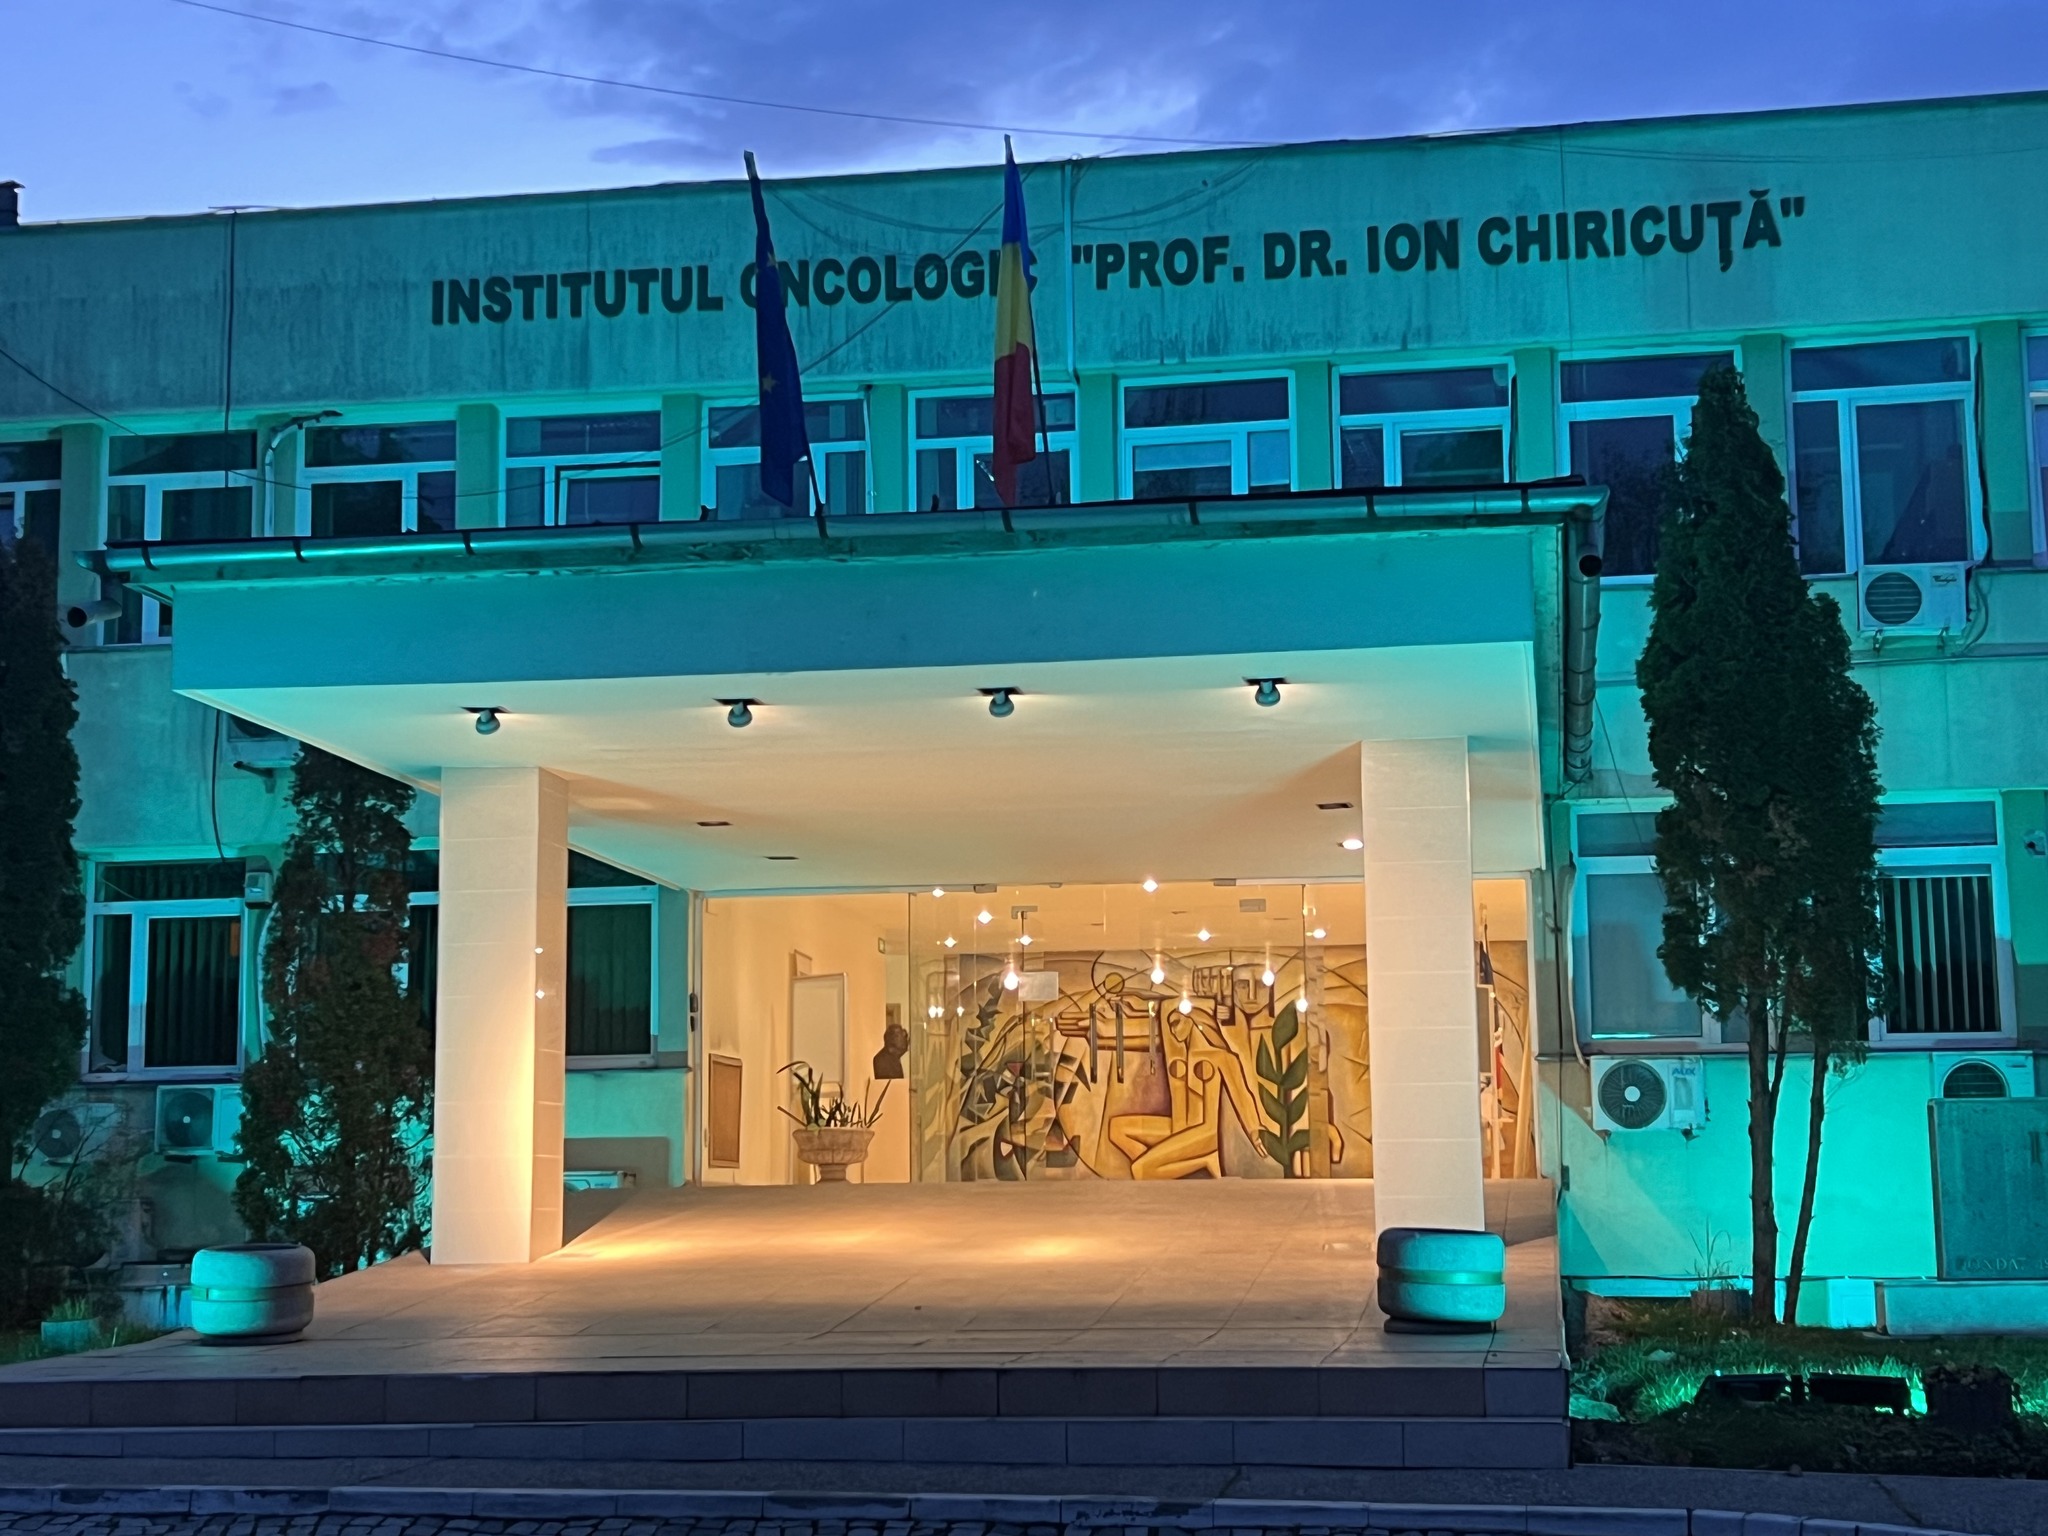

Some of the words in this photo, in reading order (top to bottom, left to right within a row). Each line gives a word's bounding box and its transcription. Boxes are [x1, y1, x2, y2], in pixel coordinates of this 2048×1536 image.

[432, 265, 724, 325] INSTITUTUL
[740, 249, 1038, 308] NCOLOGI
[1072, 235, 1244, 290] "PROF.
[1263, 229, 1347, 280] DR.
[1366, 218, 1460, 274] ION
